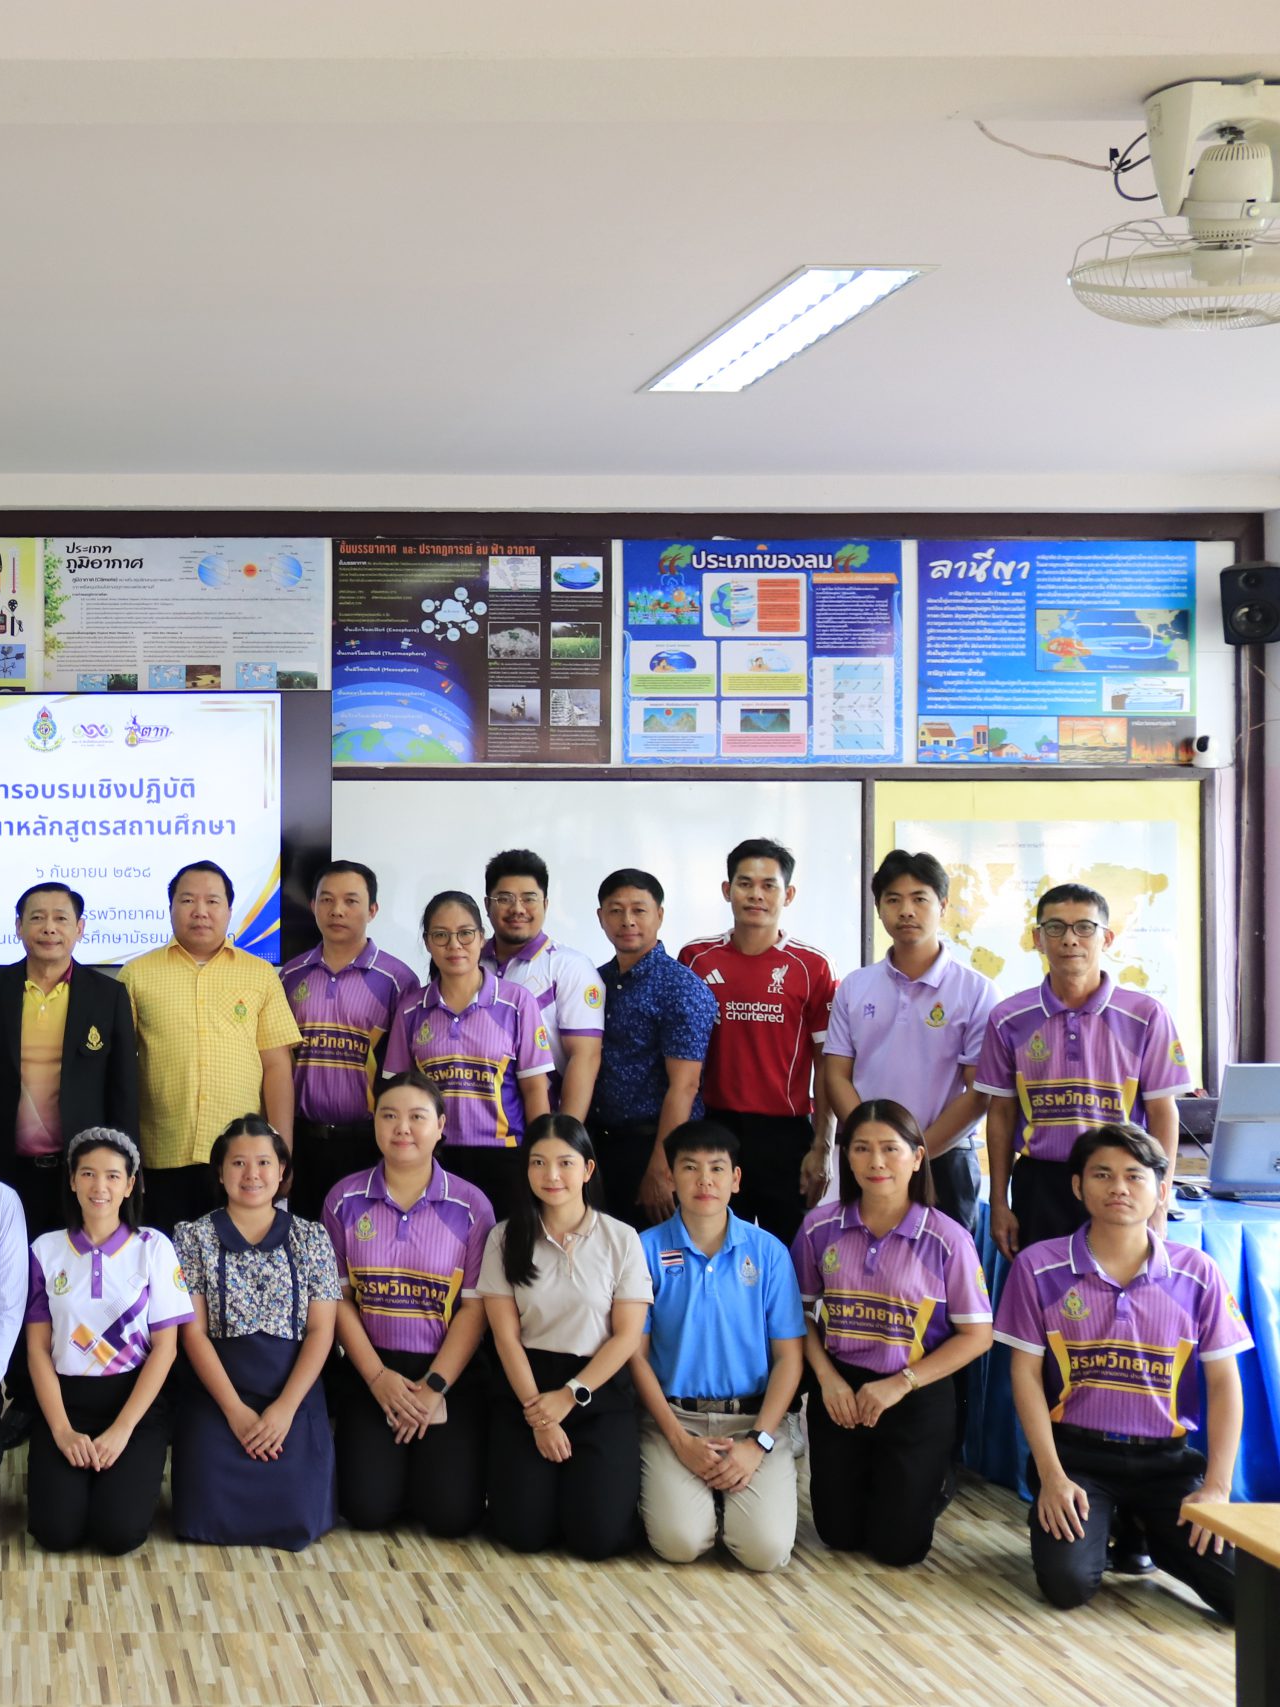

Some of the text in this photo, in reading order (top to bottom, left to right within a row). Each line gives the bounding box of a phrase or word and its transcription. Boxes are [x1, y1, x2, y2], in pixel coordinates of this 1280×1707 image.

[66, 542, 112, 554] ประเภท
[339, 542, 397, 554] ชั้นบรรยากาศ
[402, 546, 417, 554] และ
[507, 545, 536, 555] อากาศ
[66, 556, 144, 574] ภูมิอากาศ
[691, 551, 833, 569] ประเภทของลม
[928, 547, 1031, 586] ลานีญา
[50, 864, 108, 879] กันยายน
[113, 866, 152, 879] ๒๕๖๘
[767, 986, 785, 995] LFC
[725, 1001, 782, 1014] standard
[725, 1011, 785, 1024] chartered
